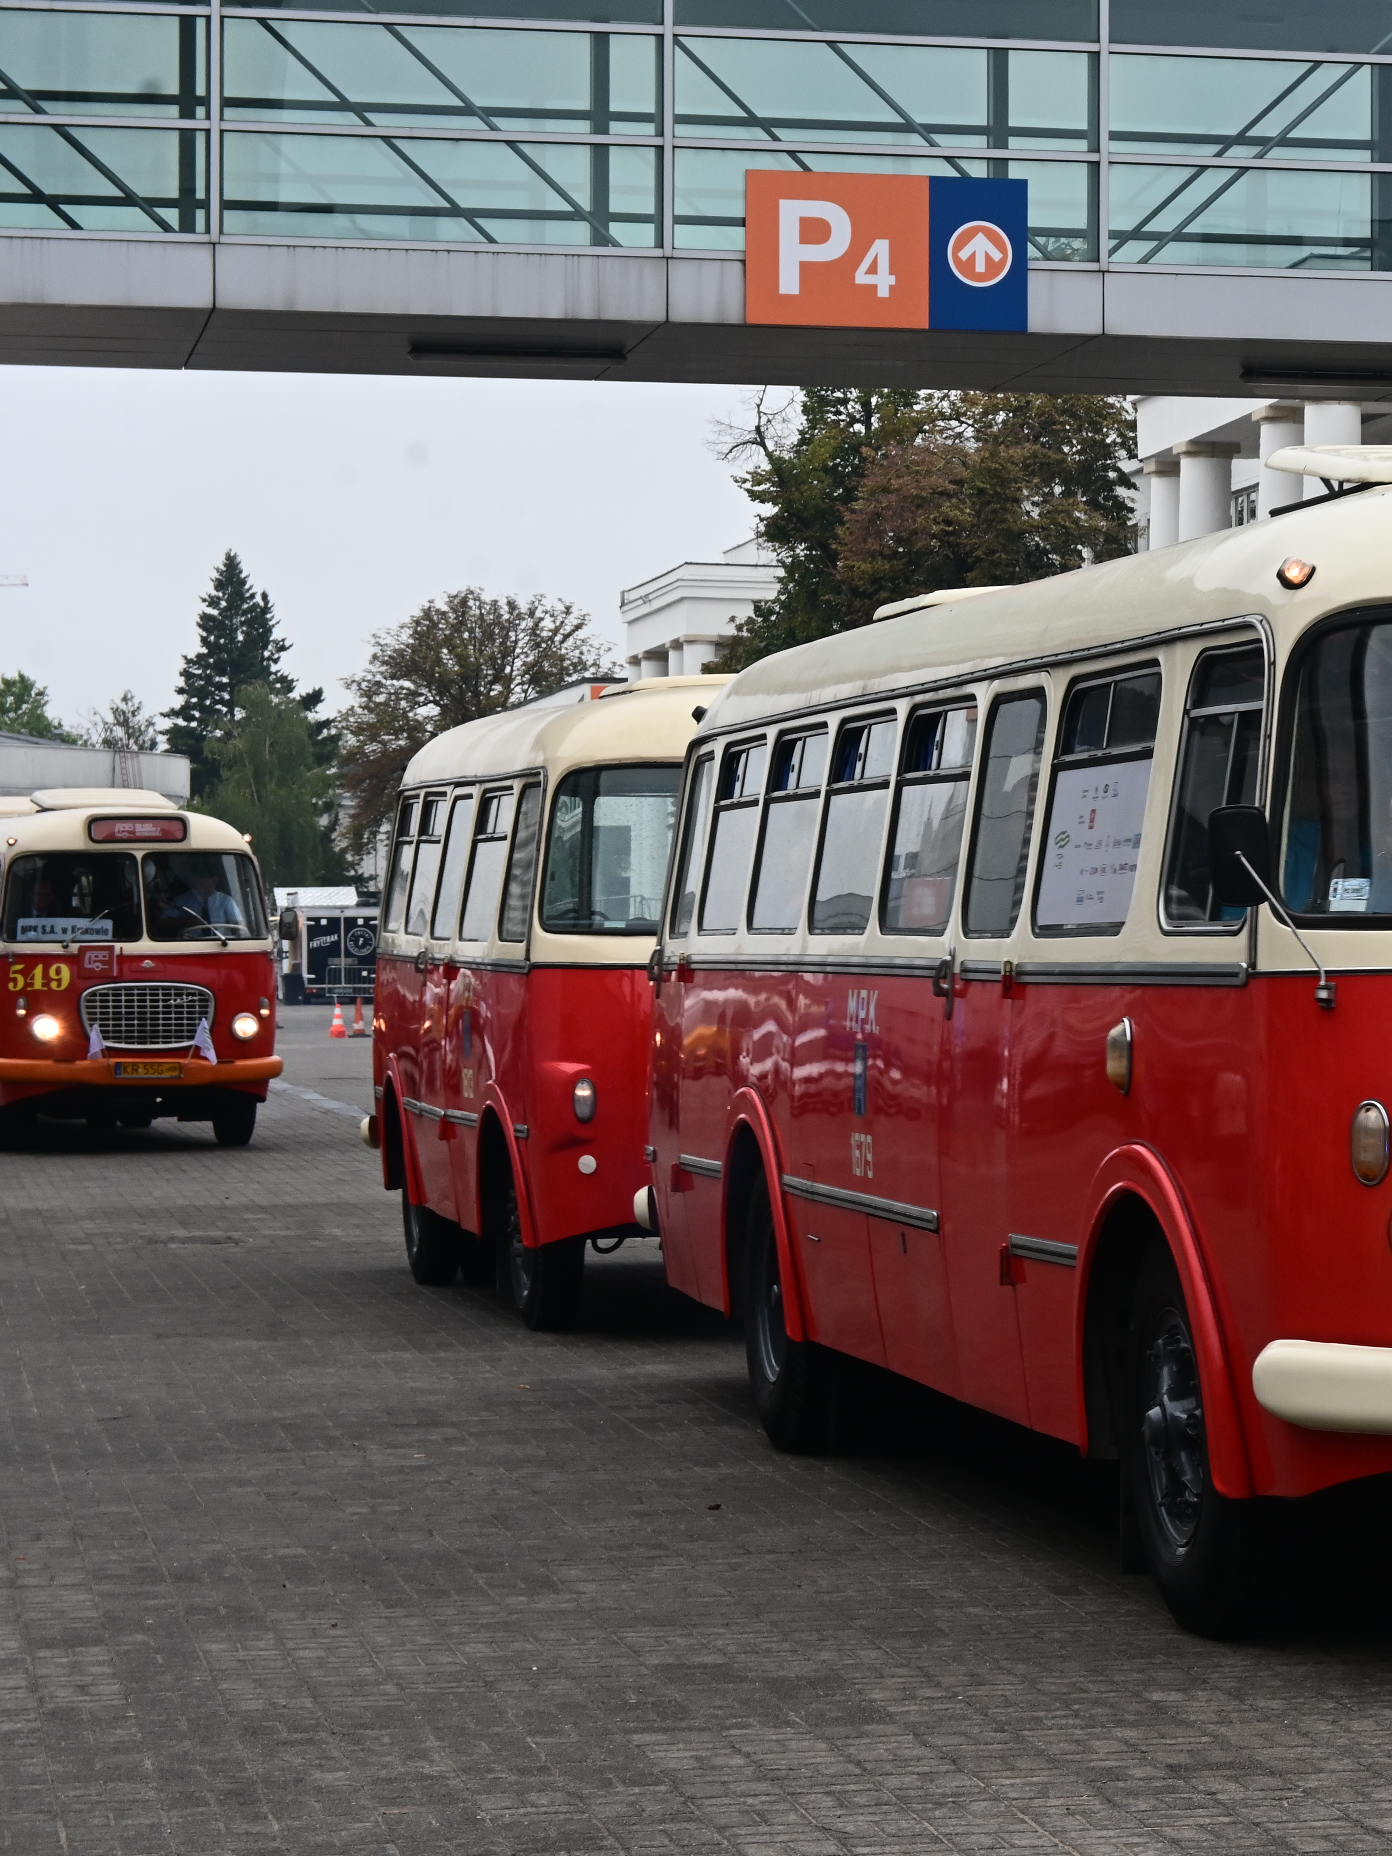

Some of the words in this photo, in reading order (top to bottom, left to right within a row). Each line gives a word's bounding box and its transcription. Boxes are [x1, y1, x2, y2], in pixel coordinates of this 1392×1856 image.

[41, 925, 58, 935] S.A.
[61, 926, 68, 935] w
[8, 963, 71, 992] 549
[851, 1132, 874, 1179] 1679
